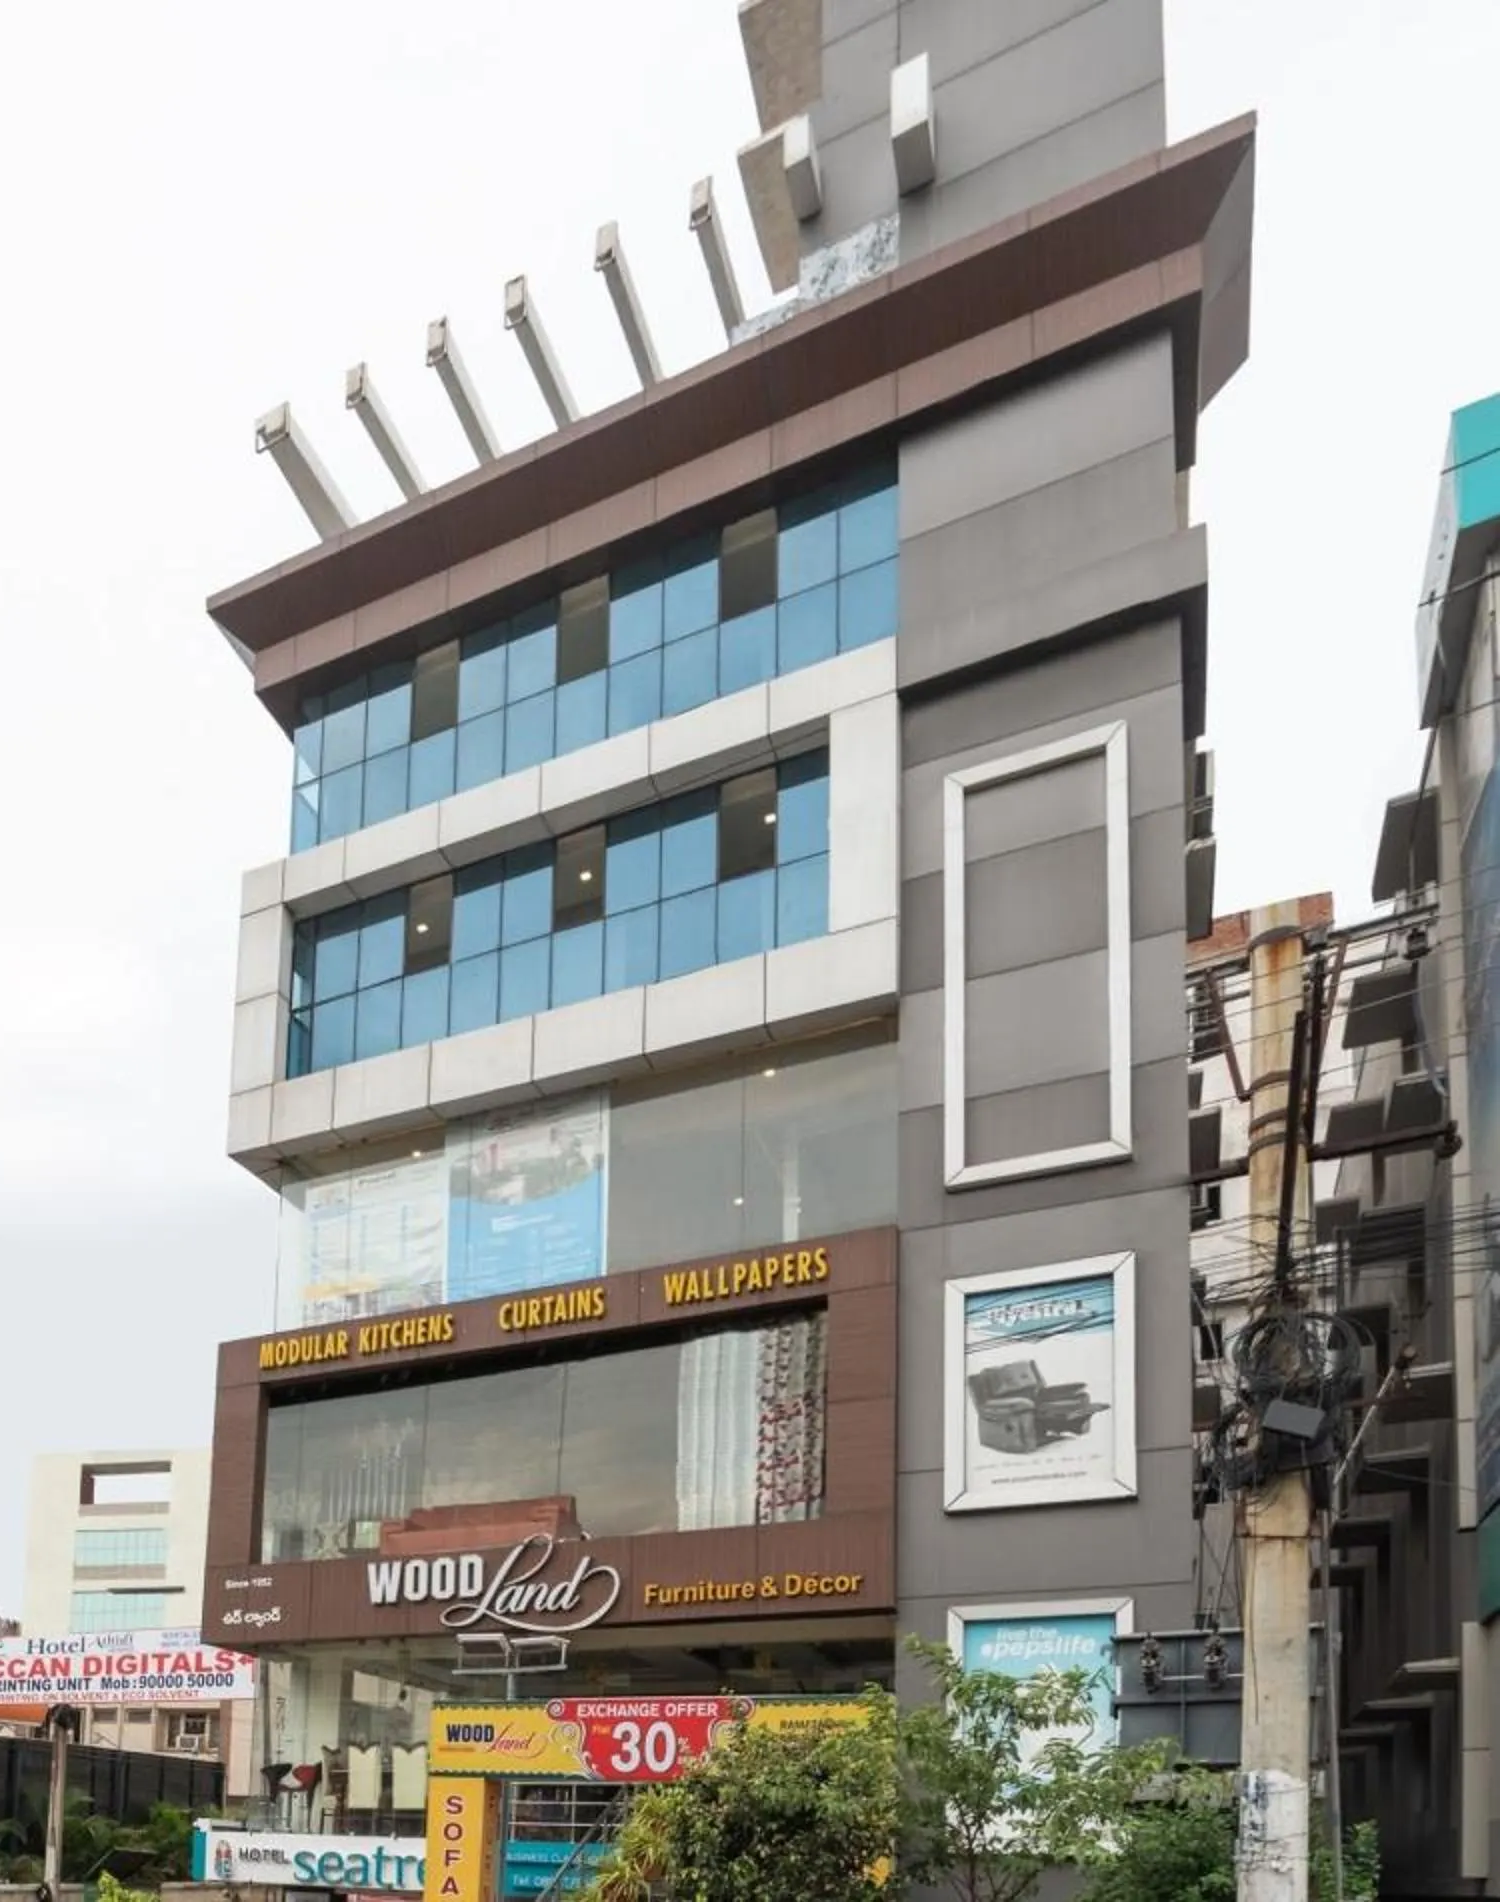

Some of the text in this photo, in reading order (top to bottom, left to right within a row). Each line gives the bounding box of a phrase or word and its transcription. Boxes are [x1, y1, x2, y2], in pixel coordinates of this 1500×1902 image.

[663, 1248, 828, 1304] WALLPAPERS
[499, 1287, 605, 1331] CURTAINS
[260, 1314, 454, 1368] MODULAR KITCHENS
[367, 1532, 621, 1632] WOOD Land
[644, 1572, 862, 1606] Furniture & Décor
[28, 1637, 86, 1655] Hotel
[83, 1649, 236, 1677] DIGITALS
[57, 1677, 92, 1691] UNIT
[187, 1672, 235, 1688] 50000
[577, 1702, 719, 1718] EXCHANGE OFFER
[446, 1723, 495, 1743] WOOD
[611, 1721, 677, 1773] 30
[239, 1847, 291, 1865] HOTEL
[441, 1795, 464, 1895] SOFA
